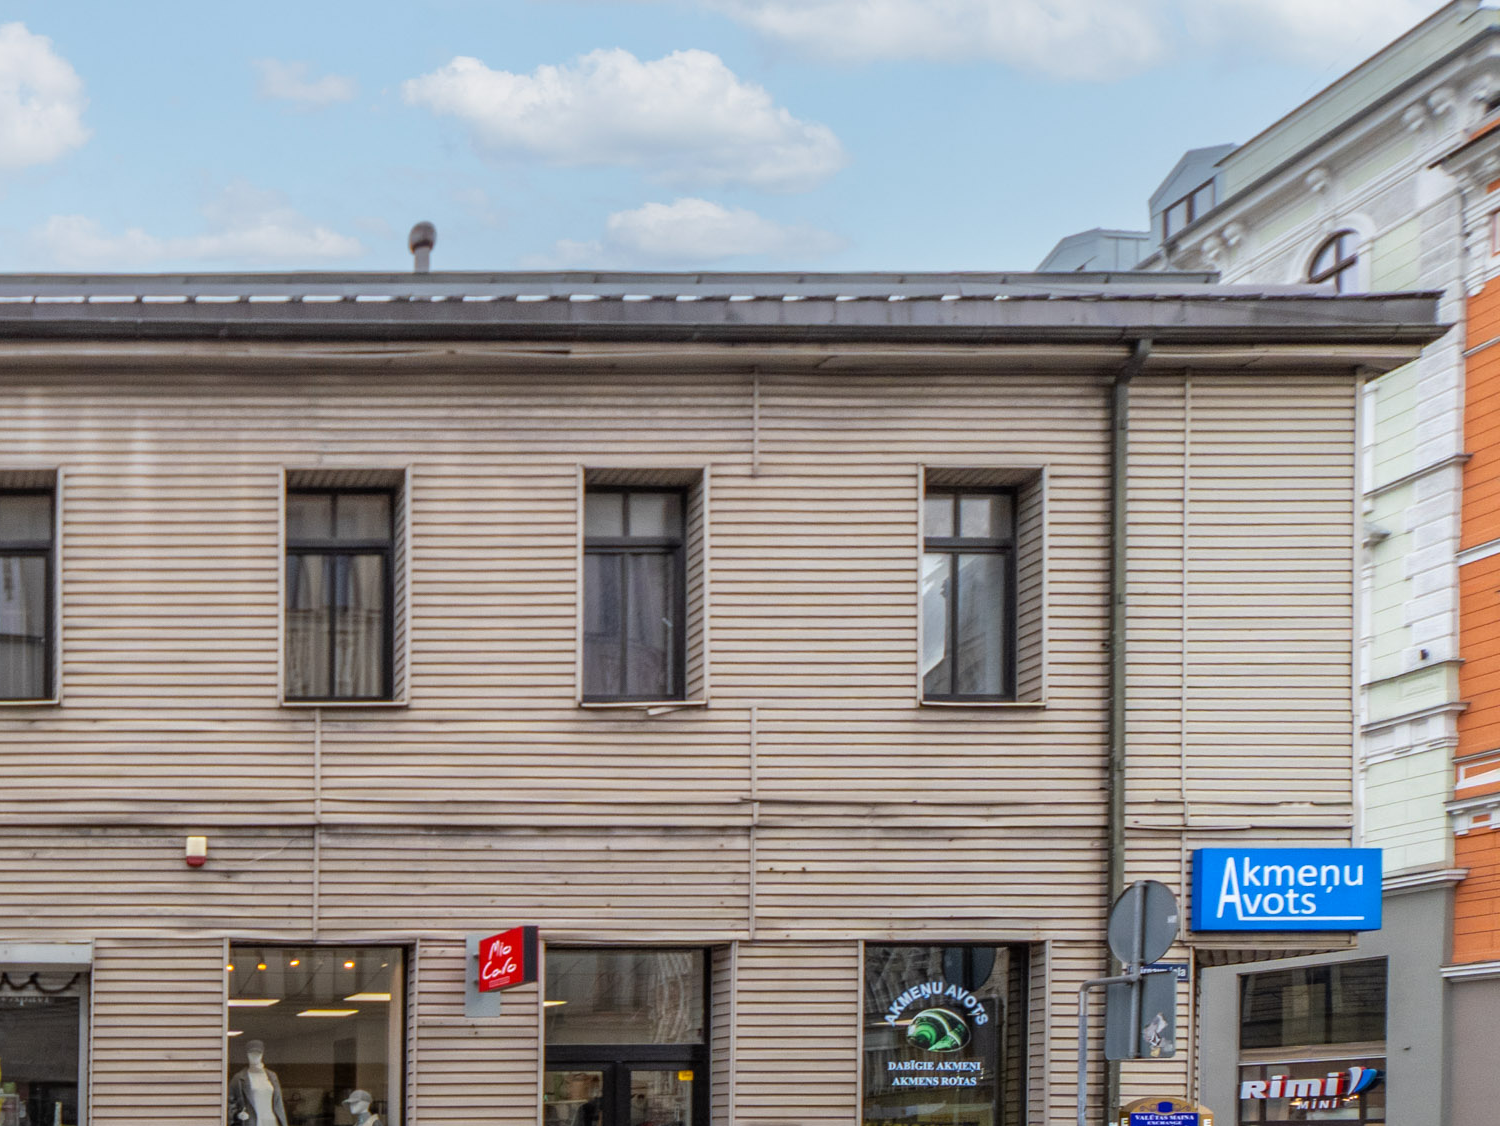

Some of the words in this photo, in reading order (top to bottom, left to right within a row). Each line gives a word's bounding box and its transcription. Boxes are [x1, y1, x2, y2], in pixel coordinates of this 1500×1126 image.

[1216, 856, 1364, 906] Akmeņu
[488, 940, 512, 960] Mio
[482, 957, 517, 980] Caro
[884, 982, 943, 1026] AKMEŅU
[944, 985, 989, 1026] AVOTS
[887, 1060, 934, 1071] DABĪGIE
[891, 1077, 939, 1086] AKMENS
[940, 1076, 977, 1086] ROTAS
